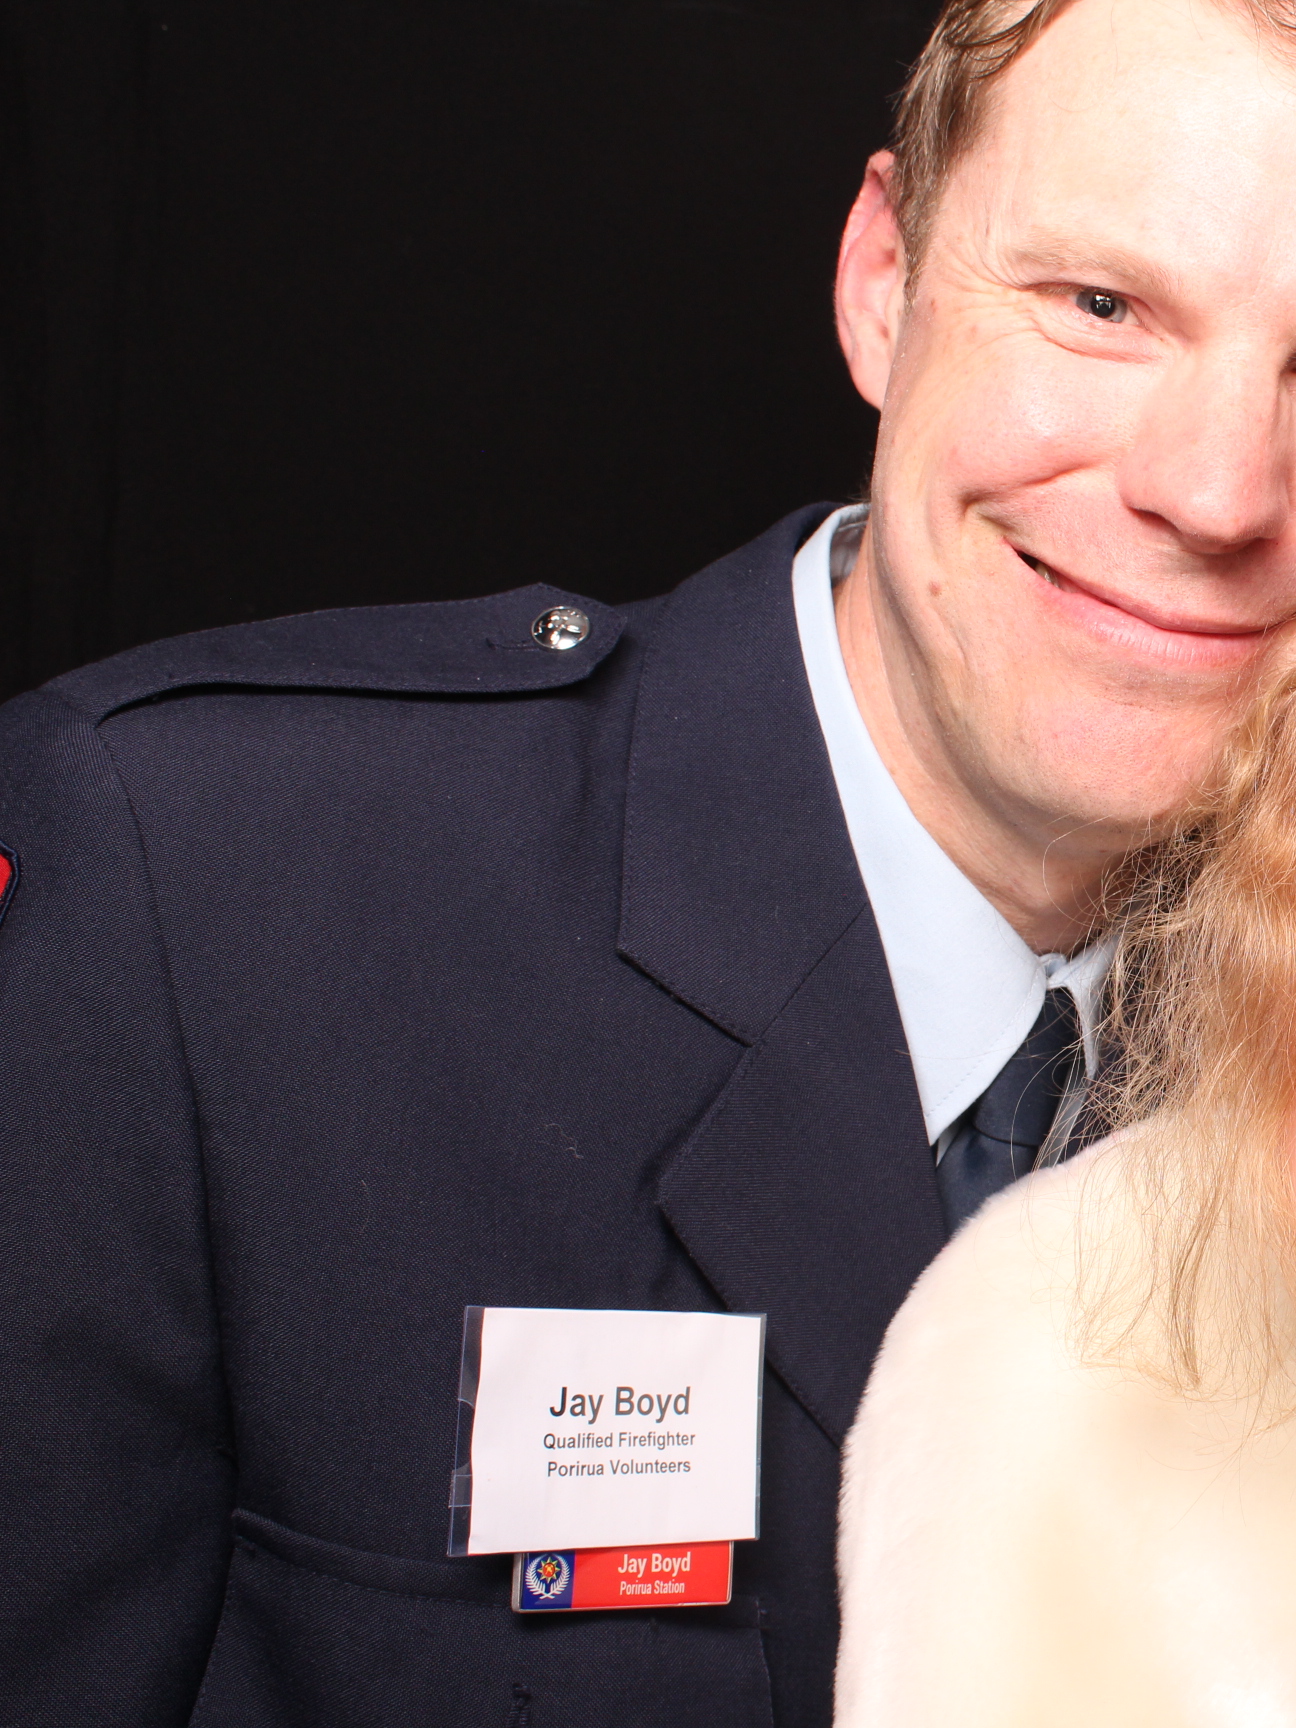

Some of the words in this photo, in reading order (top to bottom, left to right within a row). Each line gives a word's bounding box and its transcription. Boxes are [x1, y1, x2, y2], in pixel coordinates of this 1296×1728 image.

[549, 1386, 604, 1425] Jay
[614, 1386, 691, 1424] Boyd
[543, 1432, 614, 1450] Qualified
[618, 1431, 696, 1451] Firefighter
[547, 1460, 604, 1477] Porirua
[610, 1458, 691, 1475] Volunteers
[617, 1554, 648, 1578] Jay
[651, 1552, 691, 1577] Boyd
[619, 1580, 652, 1596] Porirua
[653, 1578, 685, 1594] Station
